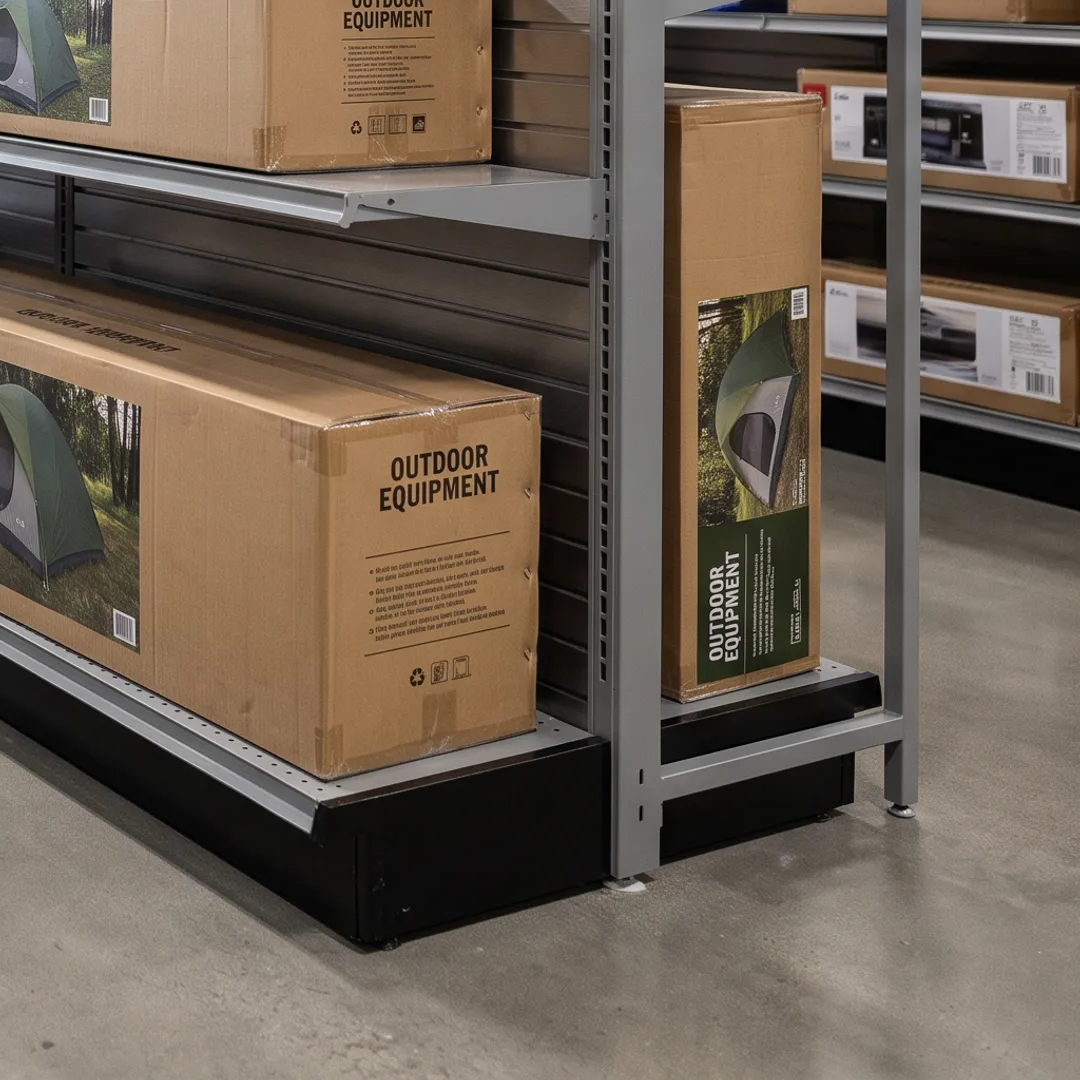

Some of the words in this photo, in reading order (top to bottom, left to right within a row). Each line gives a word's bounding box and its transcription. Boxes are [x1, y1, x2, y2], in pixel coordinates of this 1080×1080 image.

[343, 10, 433, 32] EQUIPMENT
[391, 444, 489, 482] OUTDOOR
[379, 470, 500, 513] EQUIPMENT
[708, 564, 725, 662] OUTDOOR
